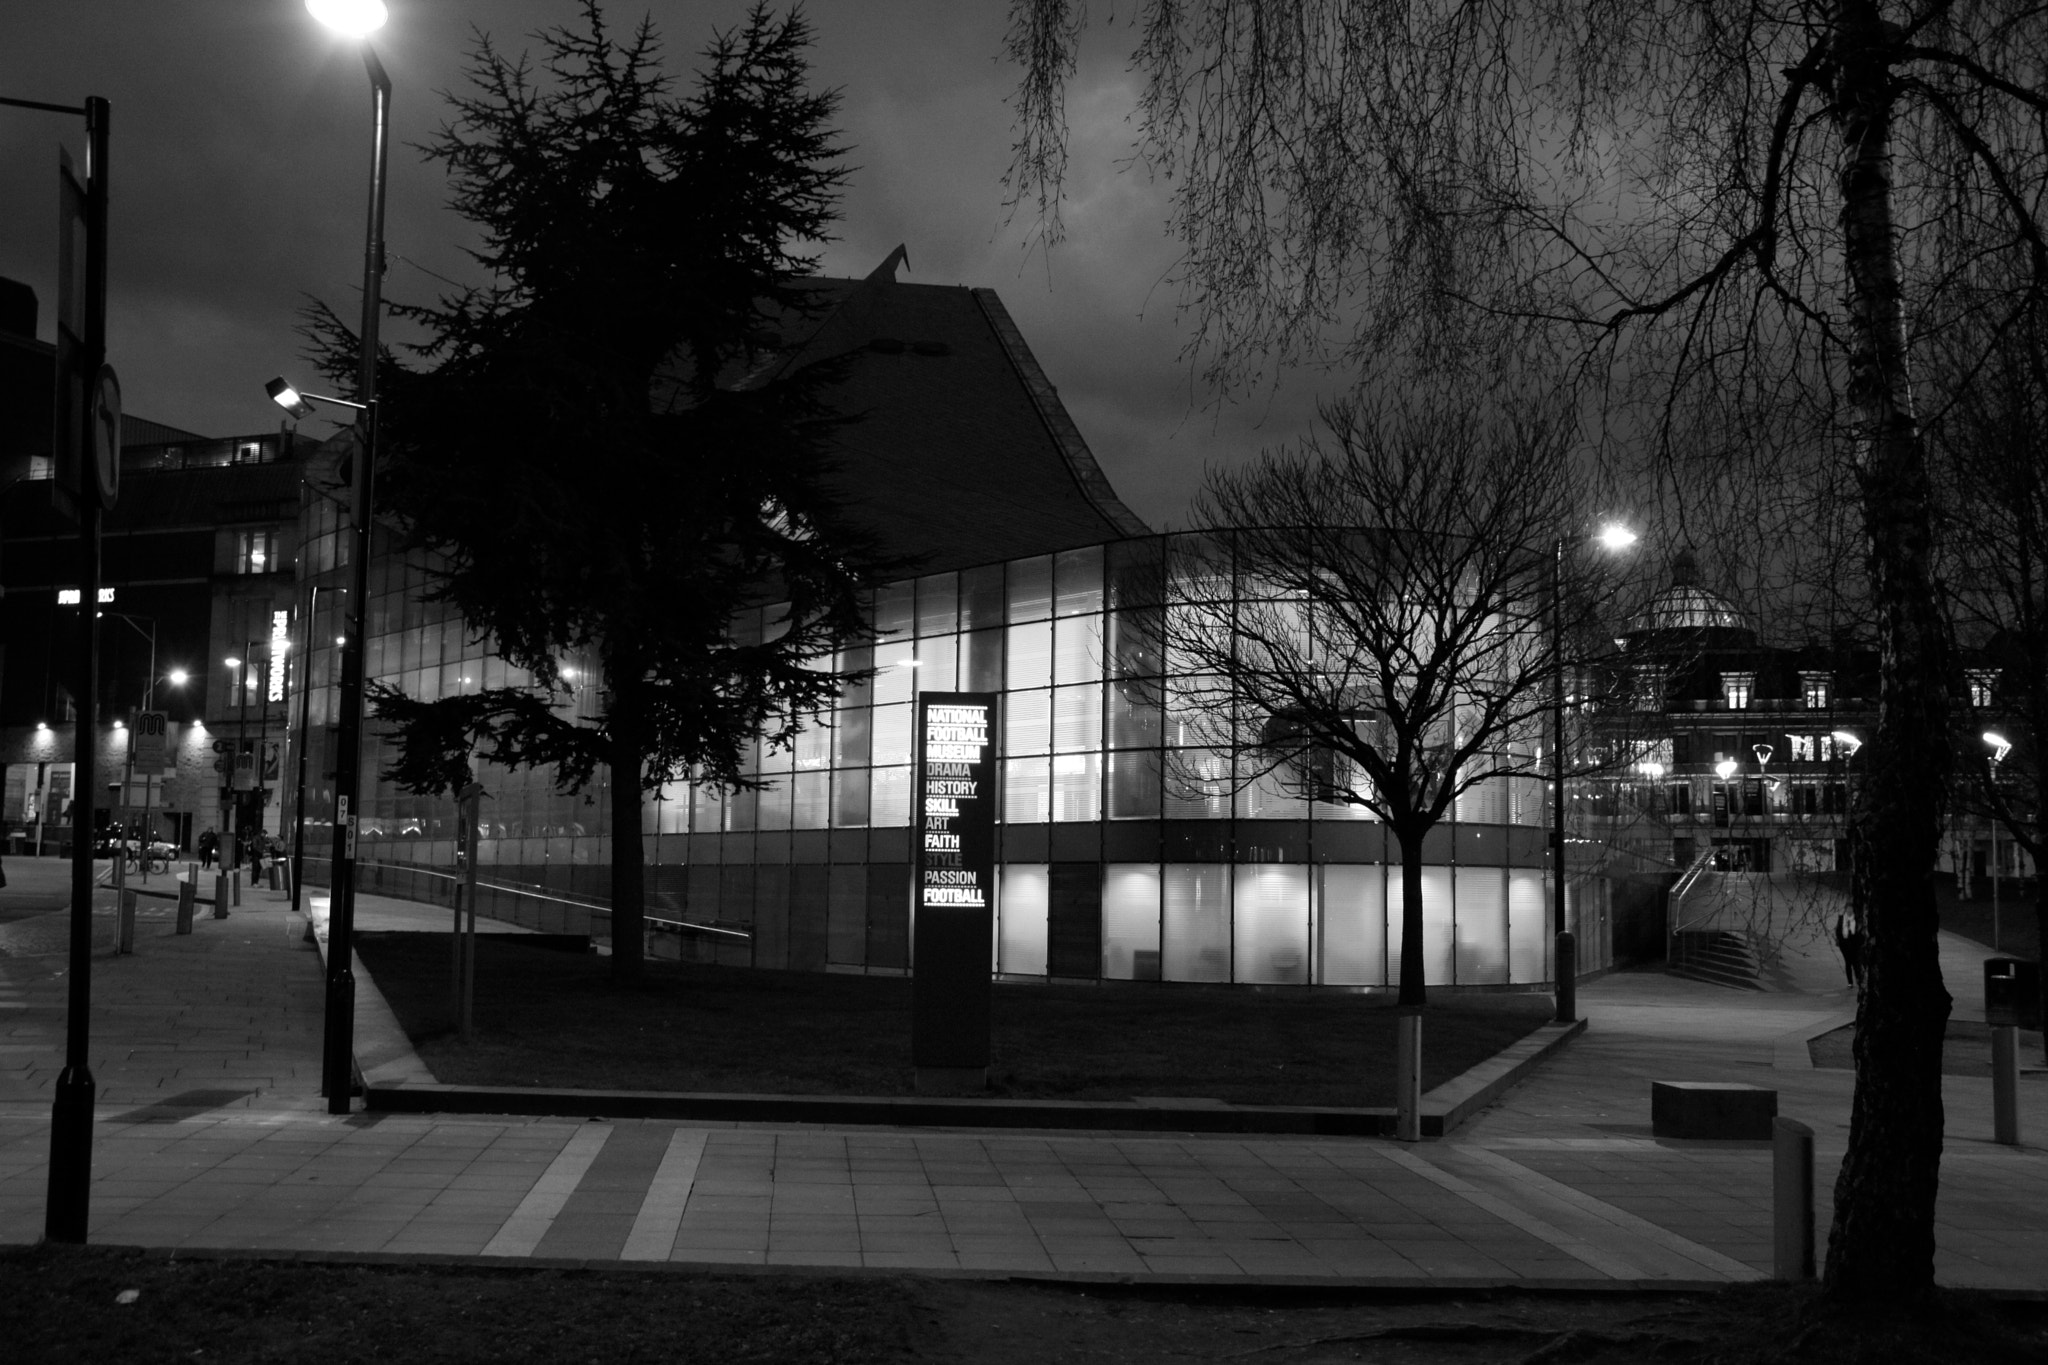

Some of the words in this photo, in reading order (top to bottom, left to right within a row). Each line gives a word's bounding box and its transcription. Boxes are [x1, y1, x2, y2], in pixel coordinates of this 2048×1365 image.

[927, 709, 987, 723] NATIONAL
[926, 727, 988, 741] FOOTBALL
[926, 745, 980, 759] MUSEUM
[926, 763, 971, 776] DRAMA
[926, 781, 977, 794] HISTORY
[925, 798, 959, 812] SKILL
[925, 817, 949, 829] ART
[925, 834, 960, 848] FAITH
[925, 853, 962, 866] STYLE
[924, 871, 977, 884] PASSION
[924, 888, 985, 902] FOOTBALL
